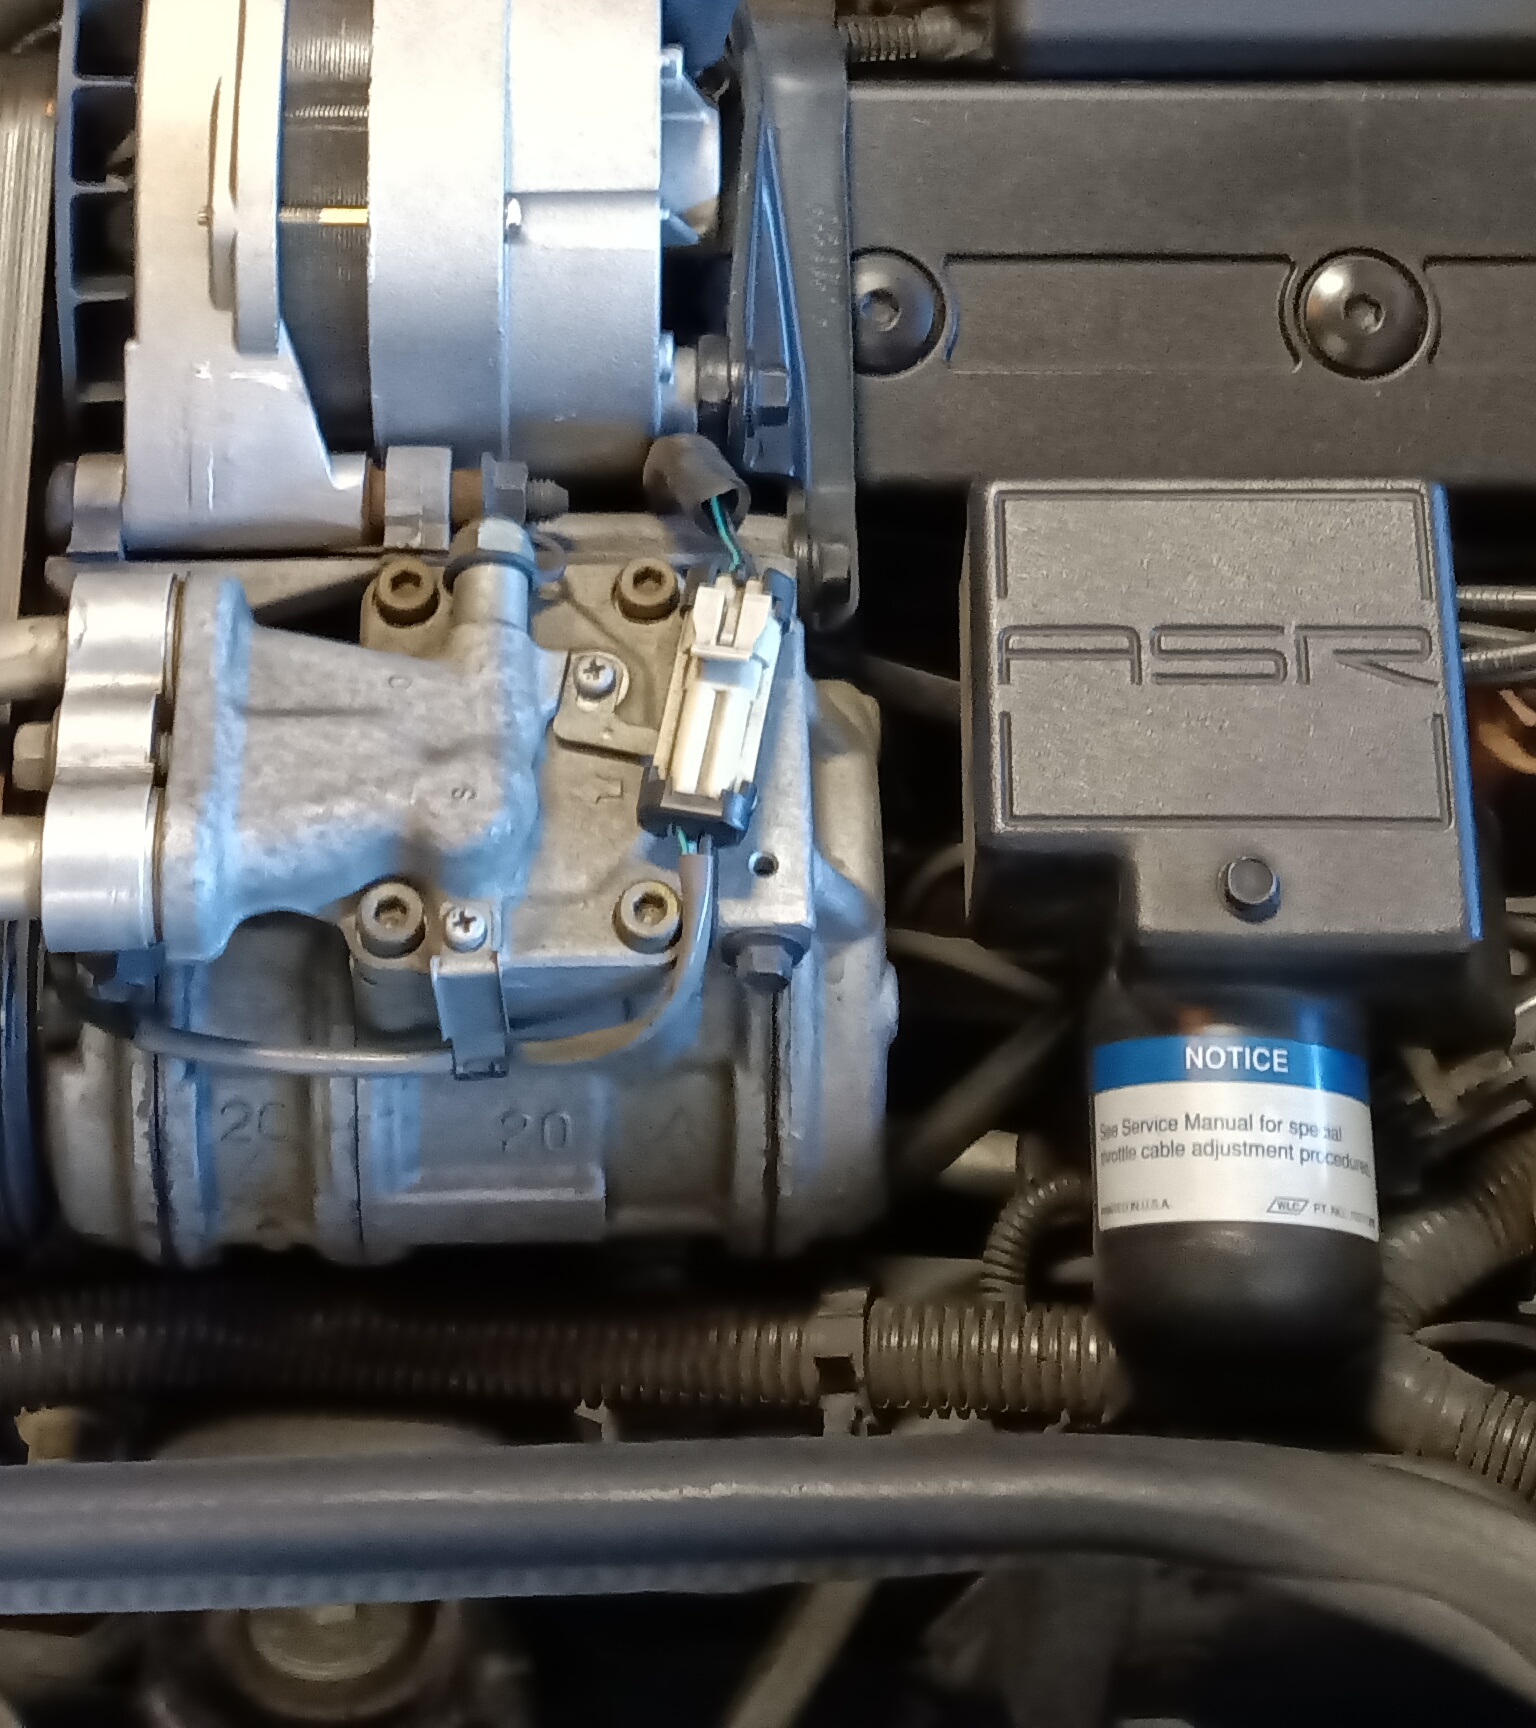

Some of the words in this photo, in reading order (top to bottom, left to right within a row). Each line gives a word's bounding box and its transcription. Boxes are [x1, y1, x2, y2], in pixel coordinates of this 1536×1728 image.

[999, 624, 1437, 685] ASR
[1185, 1046, 1289, 1073] NOTICE
[1122, 1117, 1178, 1137] Service
[1185, 1113, 1252, 1132] Manual
[1259, 1113, 1283, 1133] for
[1141, 1139, 1185, 1159] cable
[1192, 1139, 1294, 1161] adjustment
